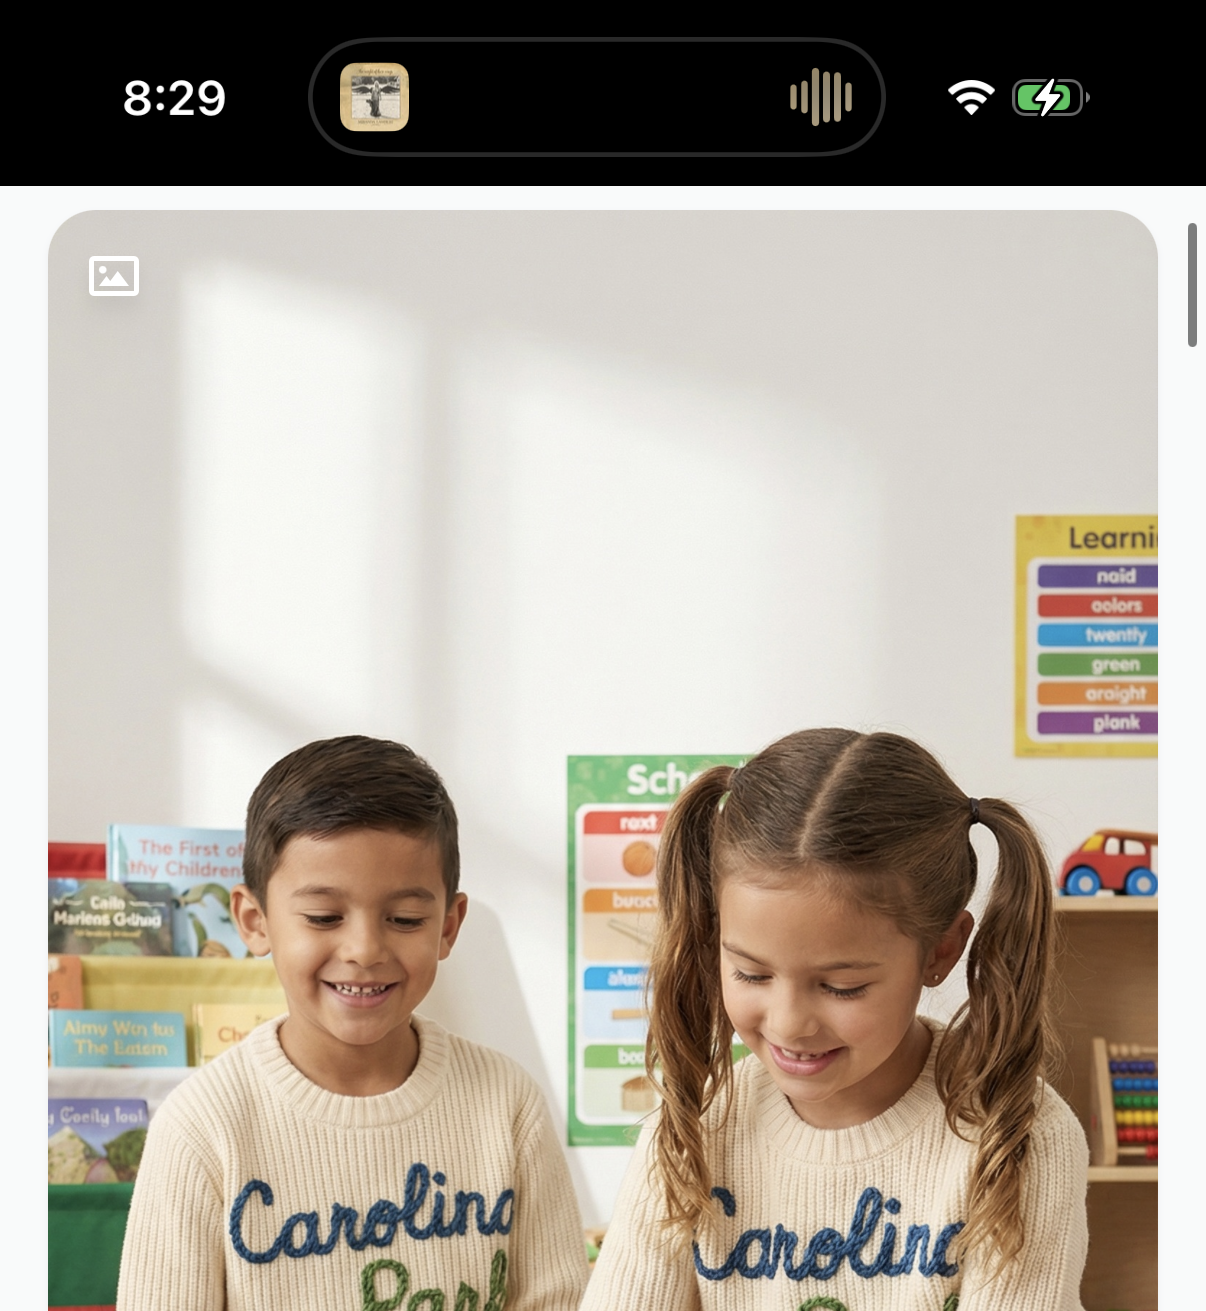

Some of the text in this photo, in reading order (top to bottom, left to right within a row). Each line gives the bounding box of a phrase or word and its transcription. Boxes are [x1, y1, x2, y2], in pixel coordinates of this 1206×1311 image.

[124, 80, 225, 116] 8:29
[1069, 525, 1158, 550] Learni
[1092, 658, 1141, 676] green
[1093, 713, 1141, 733] plank
[139, 839, 172, 856] The
[179, 841, 219, 857] First
